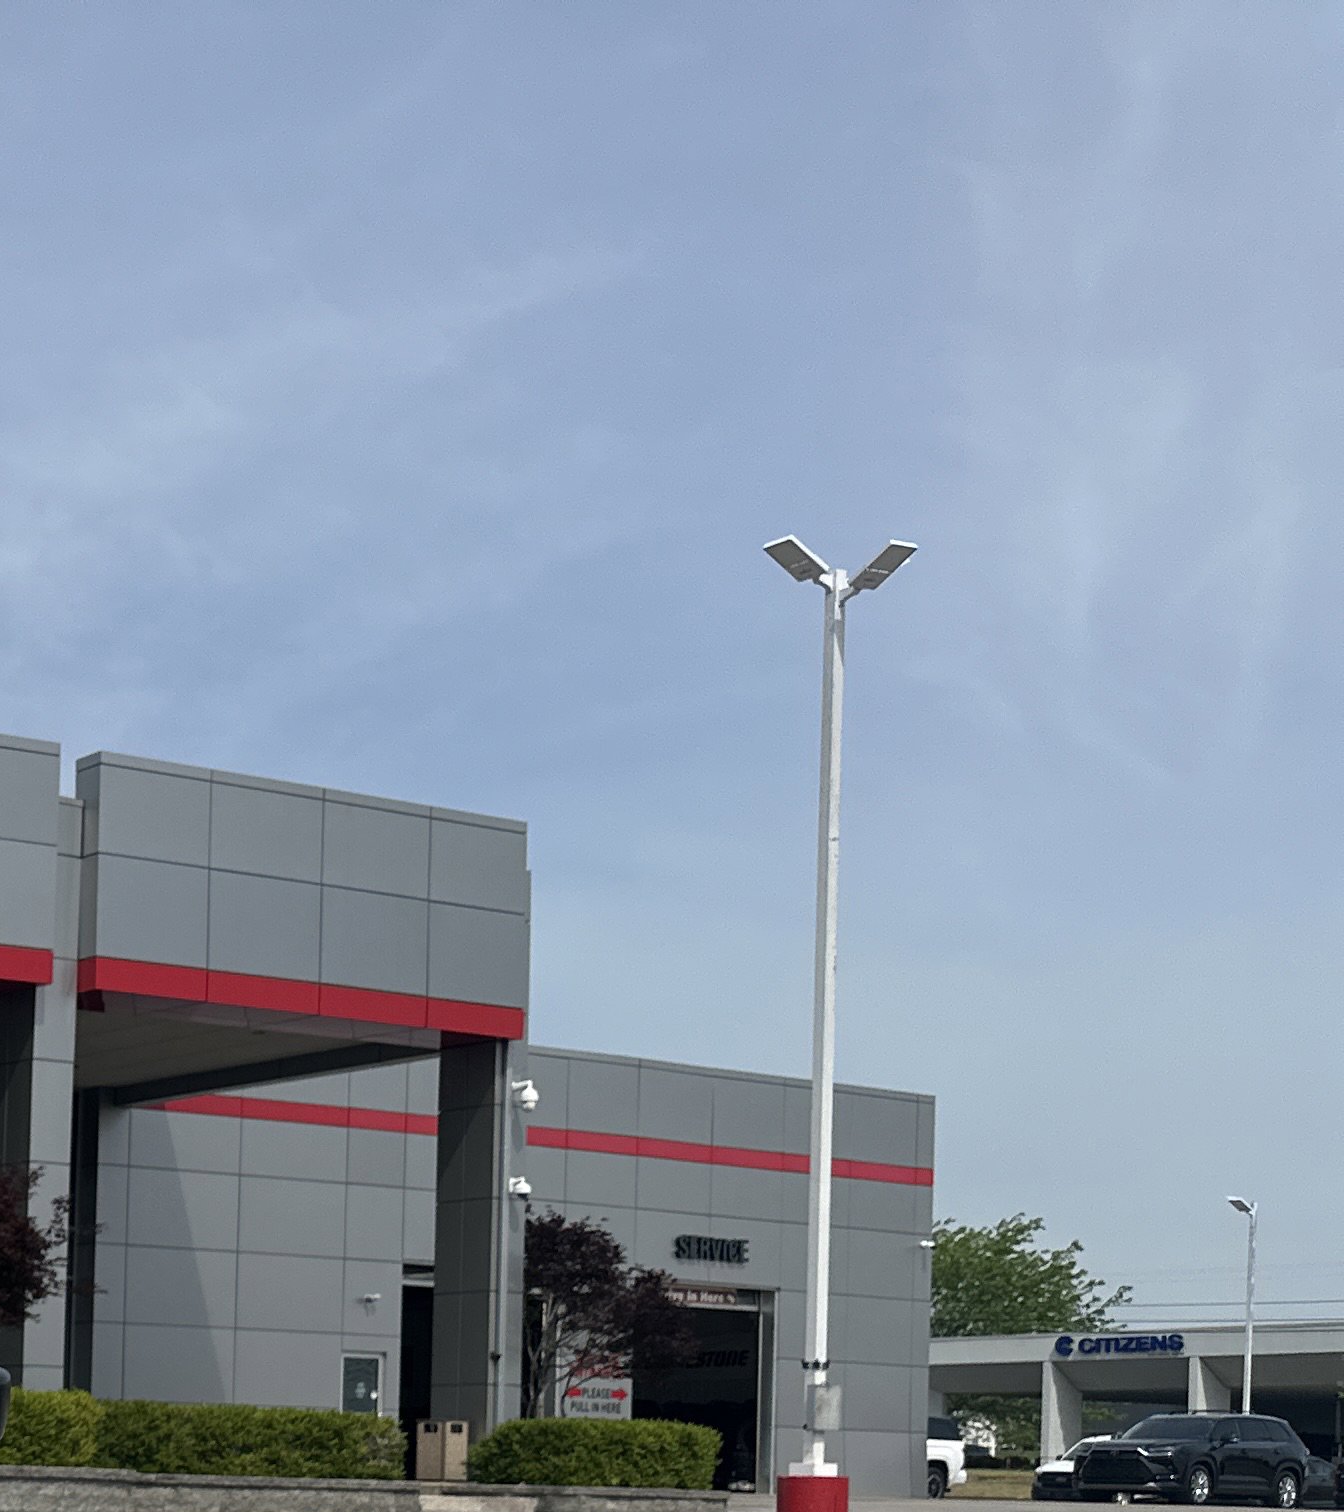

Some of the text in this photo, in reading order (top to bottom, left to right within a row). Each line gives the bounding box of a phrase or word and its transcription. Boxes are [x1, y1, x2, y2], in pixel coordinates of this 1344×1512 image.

[674, 1234, 750, 1263] SERVICE
[1078, 1334, 1185, 1354] CITIZENS
[582, 1387, 610, 1400] PLEASE
[570, 1401, 590, 1413] PULL
[601, 1403, 622, 1415] HERE
